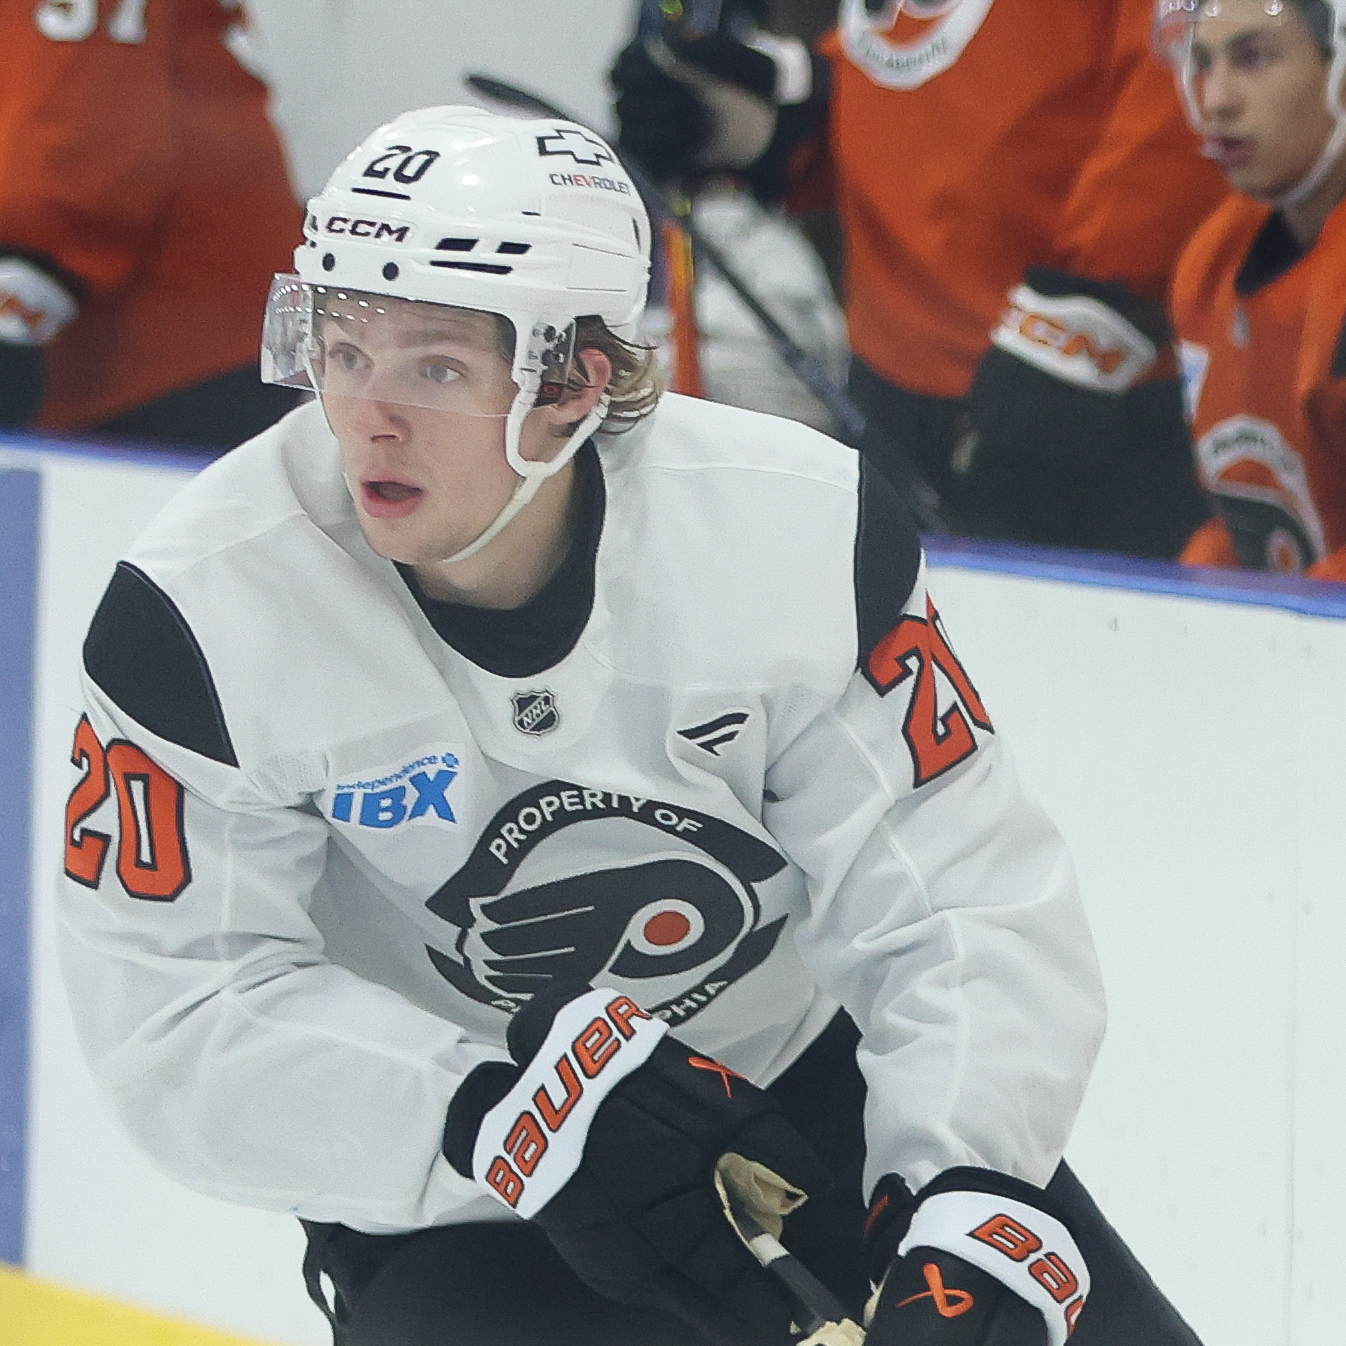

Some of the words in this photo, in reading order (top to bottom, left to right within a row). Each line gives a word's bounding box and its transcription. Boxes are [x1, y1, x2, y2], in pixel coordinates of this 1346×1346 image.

[362, 145, 440, 184] 20
[325, 216, 410, 242] CCM
[63, 711, 193, 903] 20
[331, 769, 459, 829] IBX
[488, 789, 648, 865] PROPERTY
[654, 807, 703, 834] OF
